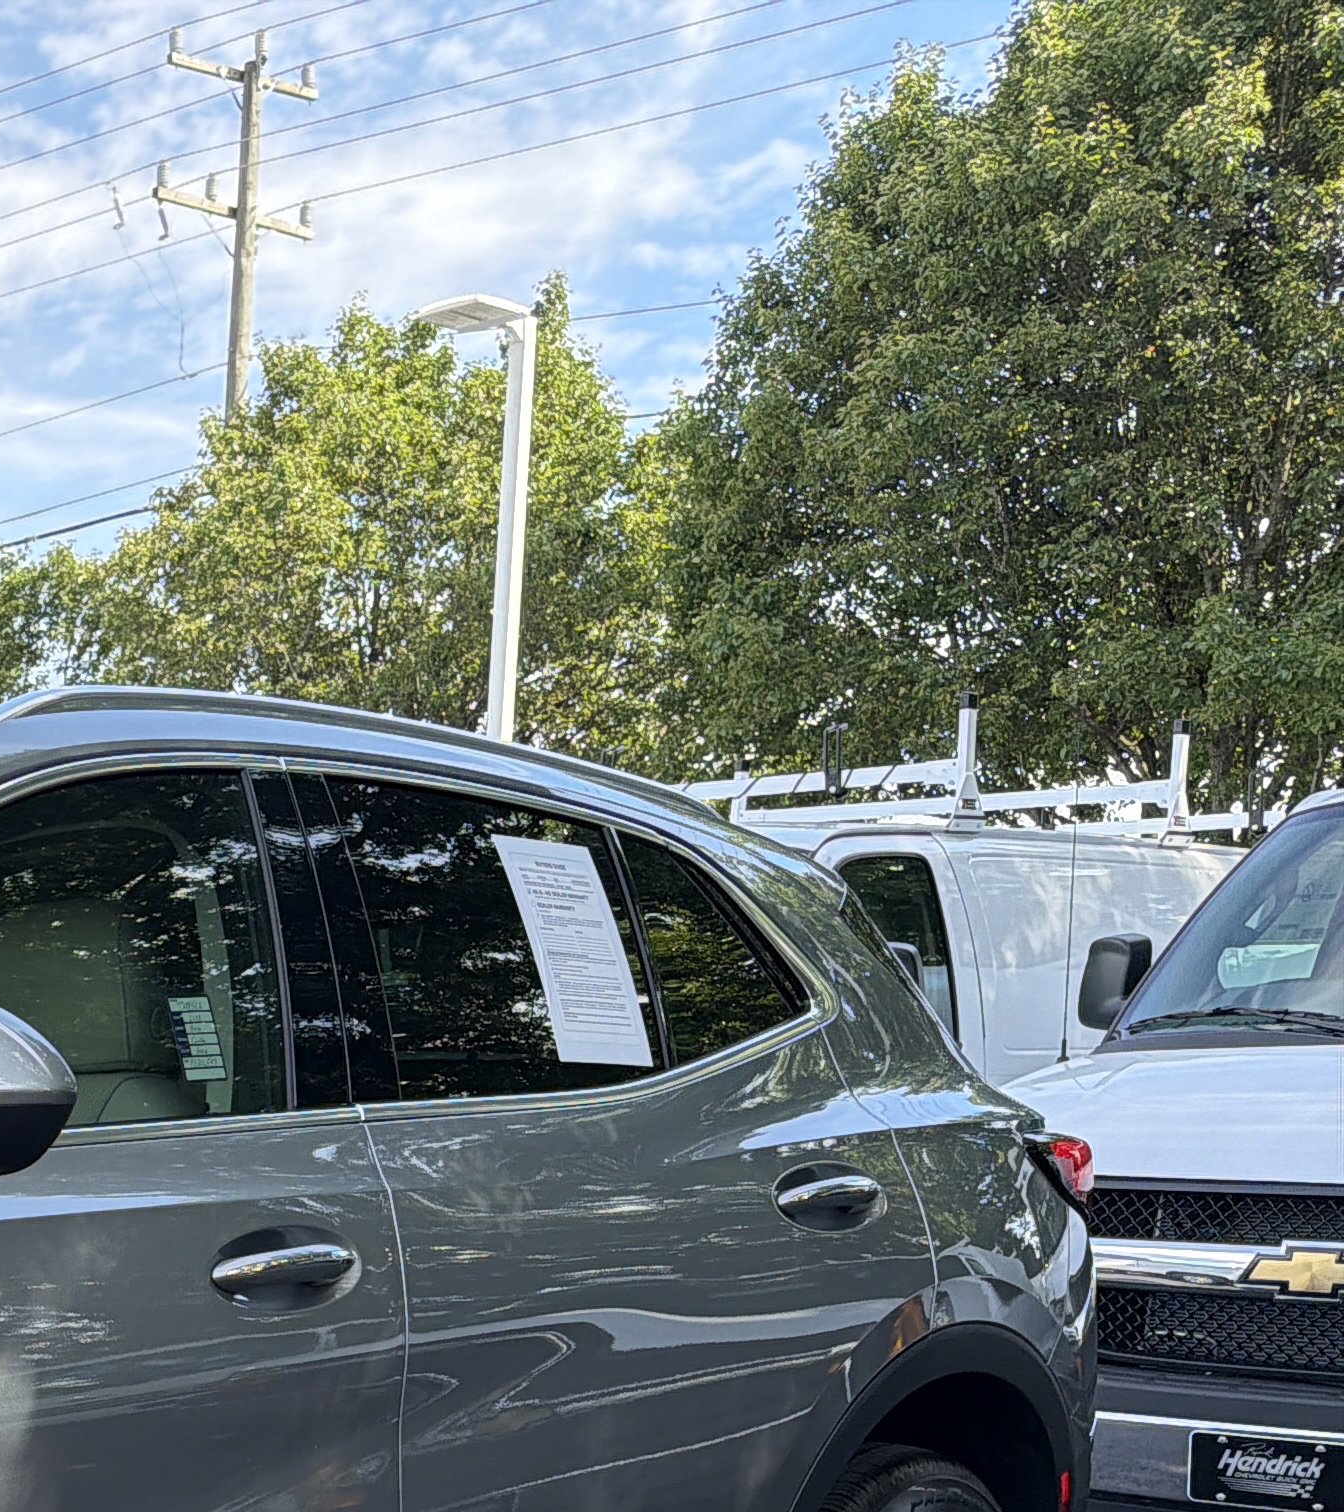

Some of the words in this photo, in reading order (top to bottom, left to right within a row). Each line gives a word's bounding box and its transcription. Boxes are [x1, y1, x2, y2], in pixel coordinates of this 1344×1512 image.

[1217, 1449, 1326, 1479] Hendrick
[1233, 1472, 1275, 1481] CHEVROLET
[1276, 1475, 1299, 1483] BUICK
